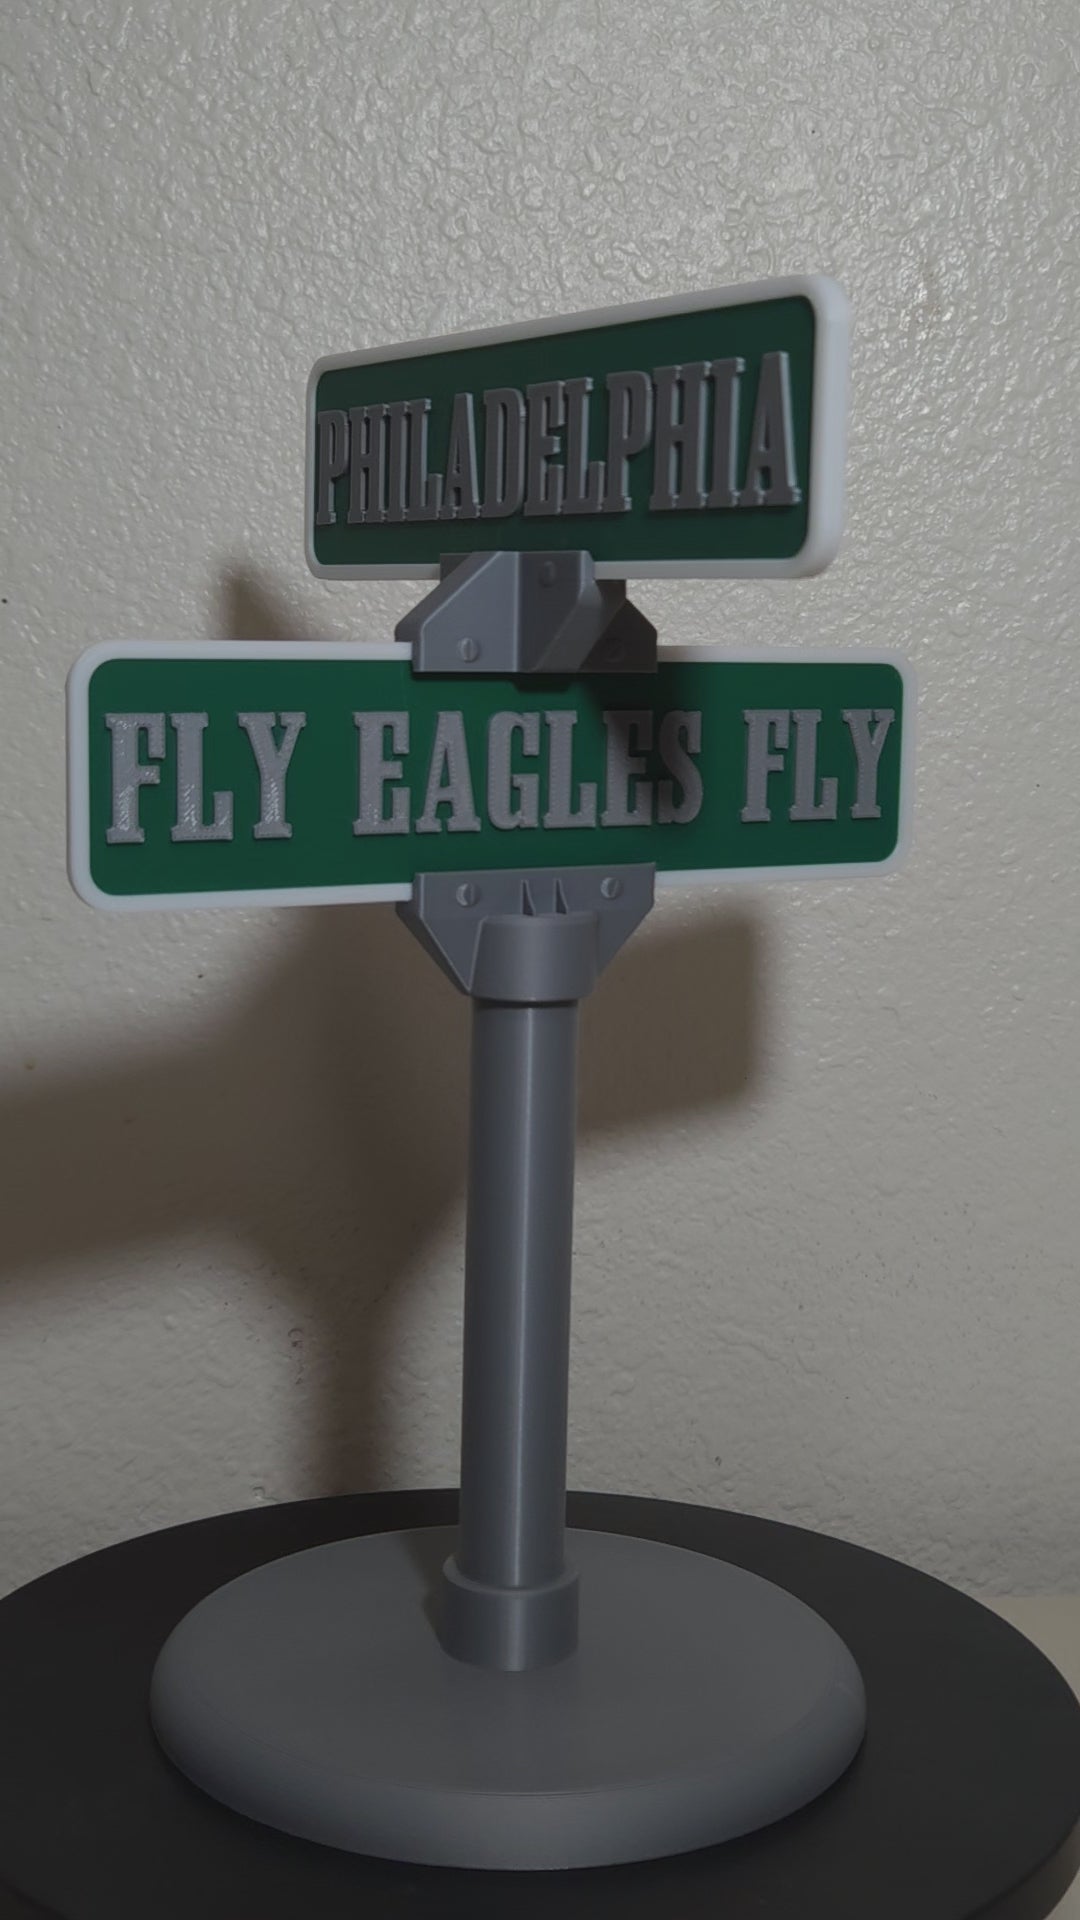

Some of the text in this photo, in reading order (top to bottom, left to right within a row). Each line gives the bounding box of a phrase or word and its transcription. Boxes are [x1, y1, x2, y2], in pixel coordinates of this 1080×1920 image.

[316, 351, 802, 525] PHILADELPHIA
[105, 708, 896, 844] FLY EAGLES FLY
